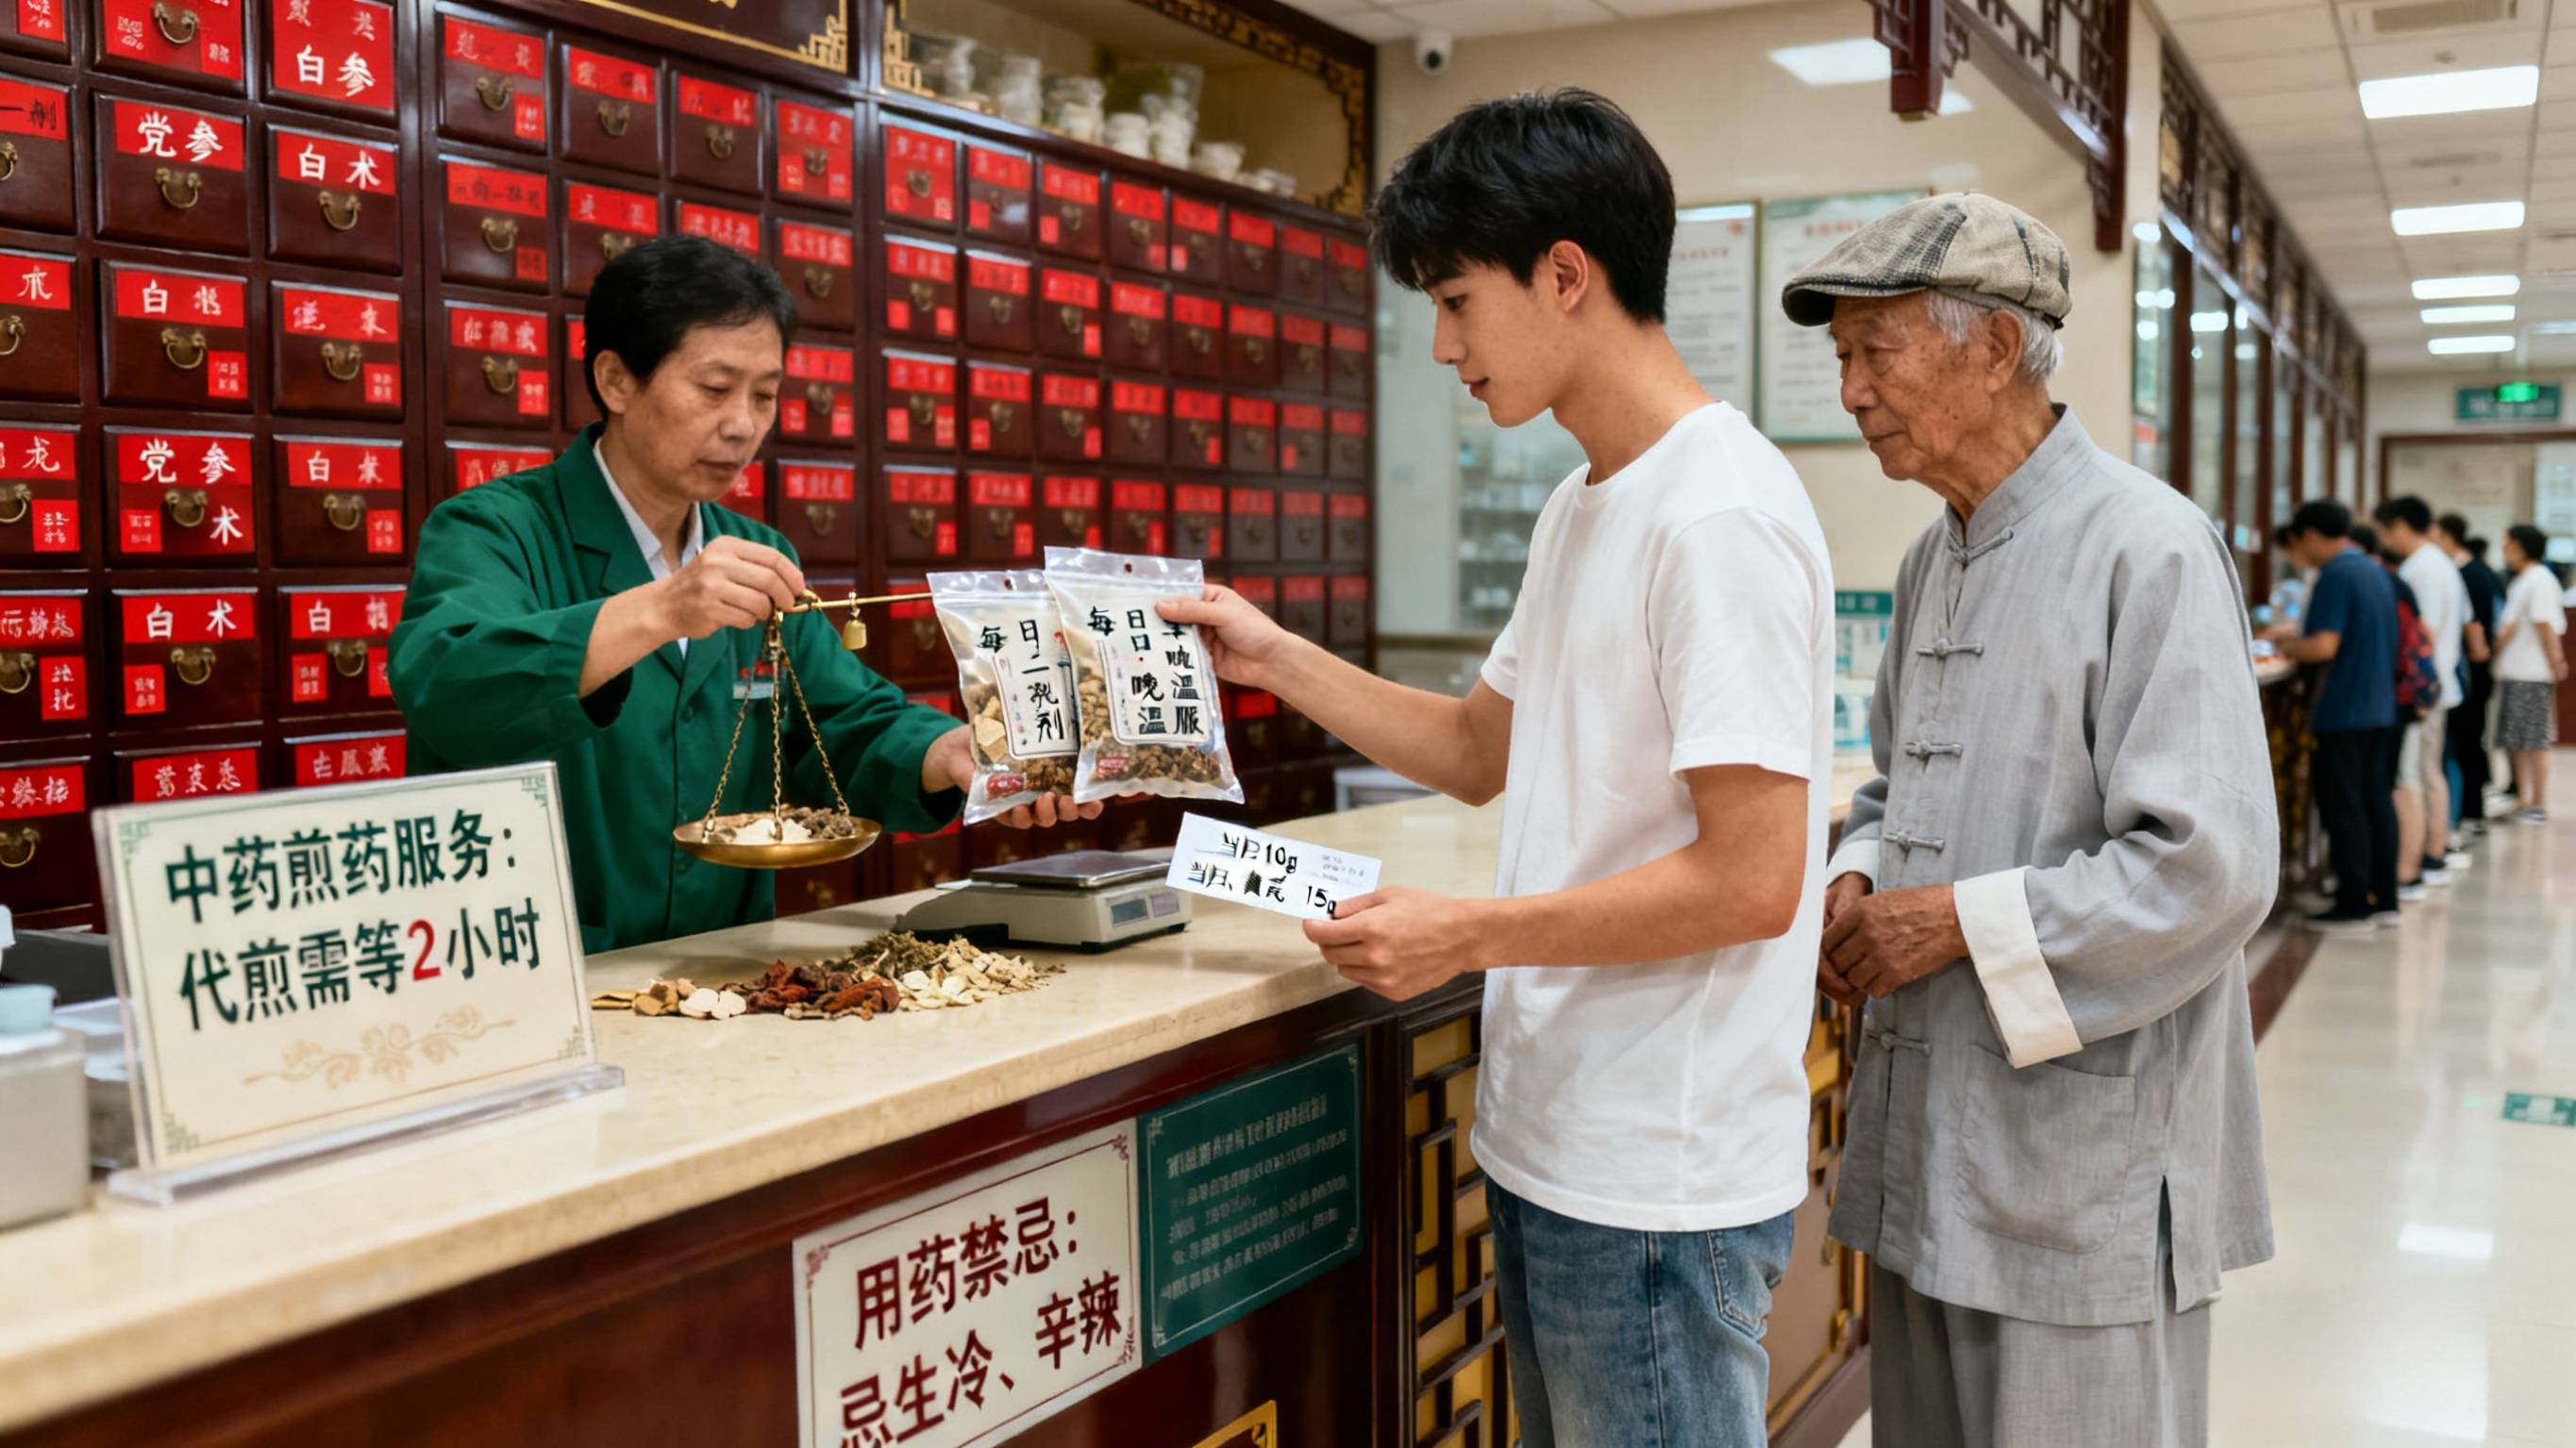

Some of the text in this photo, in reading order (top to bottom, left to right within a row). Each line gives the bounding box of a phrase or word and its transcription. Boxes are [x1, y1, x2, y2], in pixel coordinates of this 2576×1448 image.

[295, 43, 376, 97] 白参
[138, 110, 223, 162] 党参
[298, 142, 381, 189] 白术
[140, 439, 236, 484] 党参
[145, 598, 237, 639] 白术
[165, 808, 516, 924] 中药煎药服务：
[179, 897, 541, 1031] 代煎需等2小时
[855, 1196, 1077, 1350] 用药禁忌：
